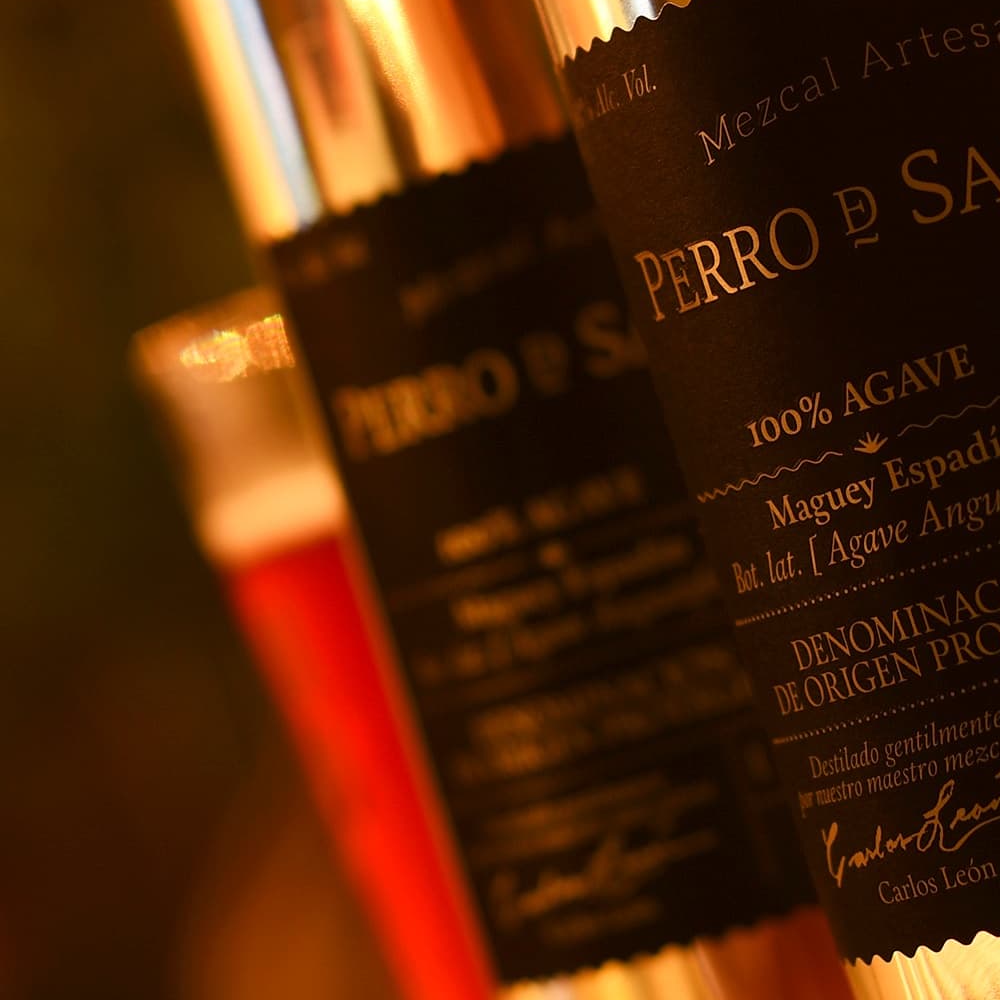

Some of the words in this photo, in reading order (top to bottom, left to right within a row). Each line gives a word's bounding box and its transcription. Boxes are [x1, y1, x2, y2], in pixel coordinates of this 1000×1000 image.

[622, 63, 657, 101] Vol.
[696, 55, 841, 166] Mezcal
[633, 206, 821, 322] PERRO
[746, 391, 833, 448] 100%
[842, 343, 977, 416] AGAVE
[765, 475, 877, 530] Maguey
[731, 561, 764, 594] Bot.
[765, 548, 803, 584] lat.
[828, 519, 910, 569] Agave
[772, 680, 803, 717] DE
[803, 647, 923, 709] ORIGEN
[807, 739, 880, 780] Destilado
[816, 777, 864, 808] nuestro
[866, 758, 938, 792] maestro
[877, 868, 939, 905] Carlos
[940, 856, 999, 890] León
